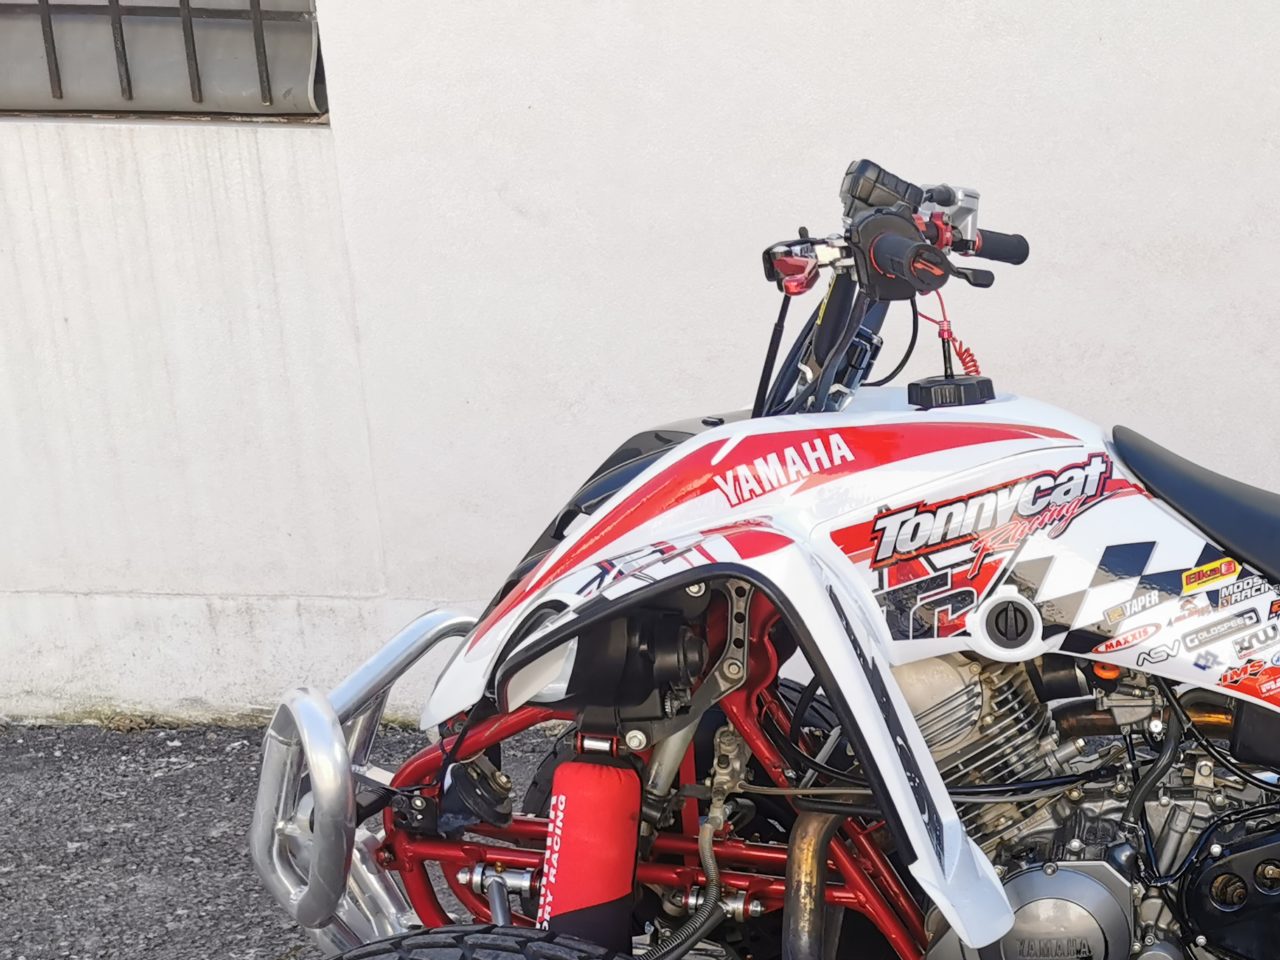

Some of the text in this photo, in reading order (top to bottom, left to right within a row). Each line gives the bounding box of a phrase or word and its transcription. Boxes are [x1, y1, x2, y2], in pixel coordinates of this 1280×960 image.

[713, 433, 855, 505] YAMAHA
[1124, 590, 1159, 615] TAPER
[1105, 628, 1149, 651] MAXXIS
[1222, 660, 1265, 685] IMS
[549, 794, 566, 883] RACING
[1016, 937, 1094, 960] YAMAHA
